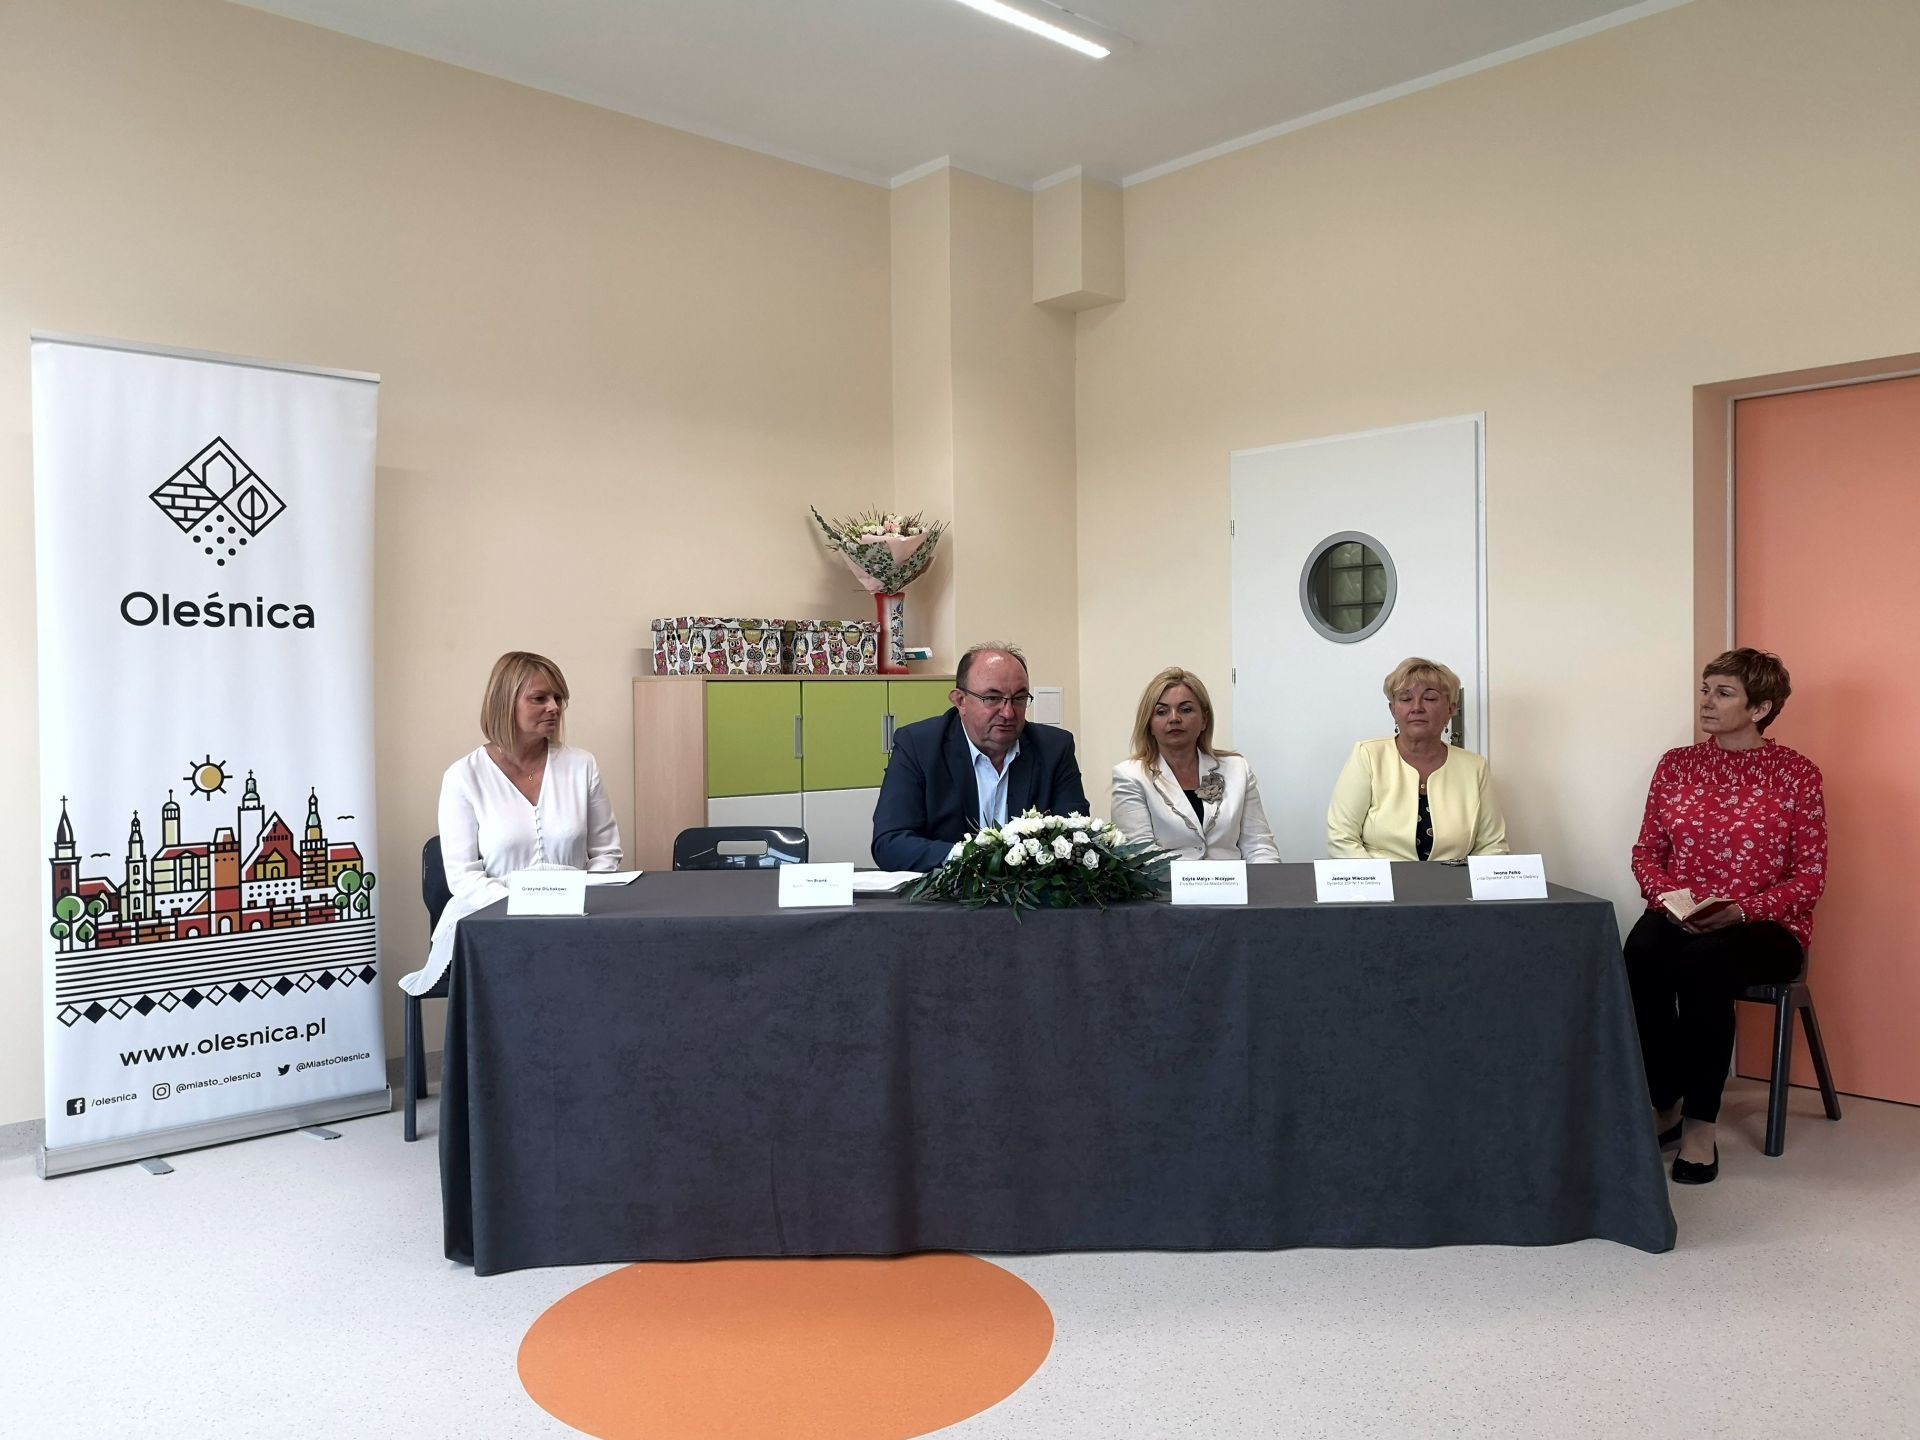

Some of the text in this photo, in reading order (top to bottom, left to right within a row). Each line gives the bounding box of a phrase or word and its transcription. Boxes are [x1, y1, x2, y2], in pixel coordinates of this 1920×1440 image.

[120, 591, 315, 630] Oleśnica
[120, 1018, 326, 1067] www.olesnica.pl
[295, 1052, 371, 1073] @MiastoOlesnica
[175, 1071, 262, 1095] @miasto_olesnica
